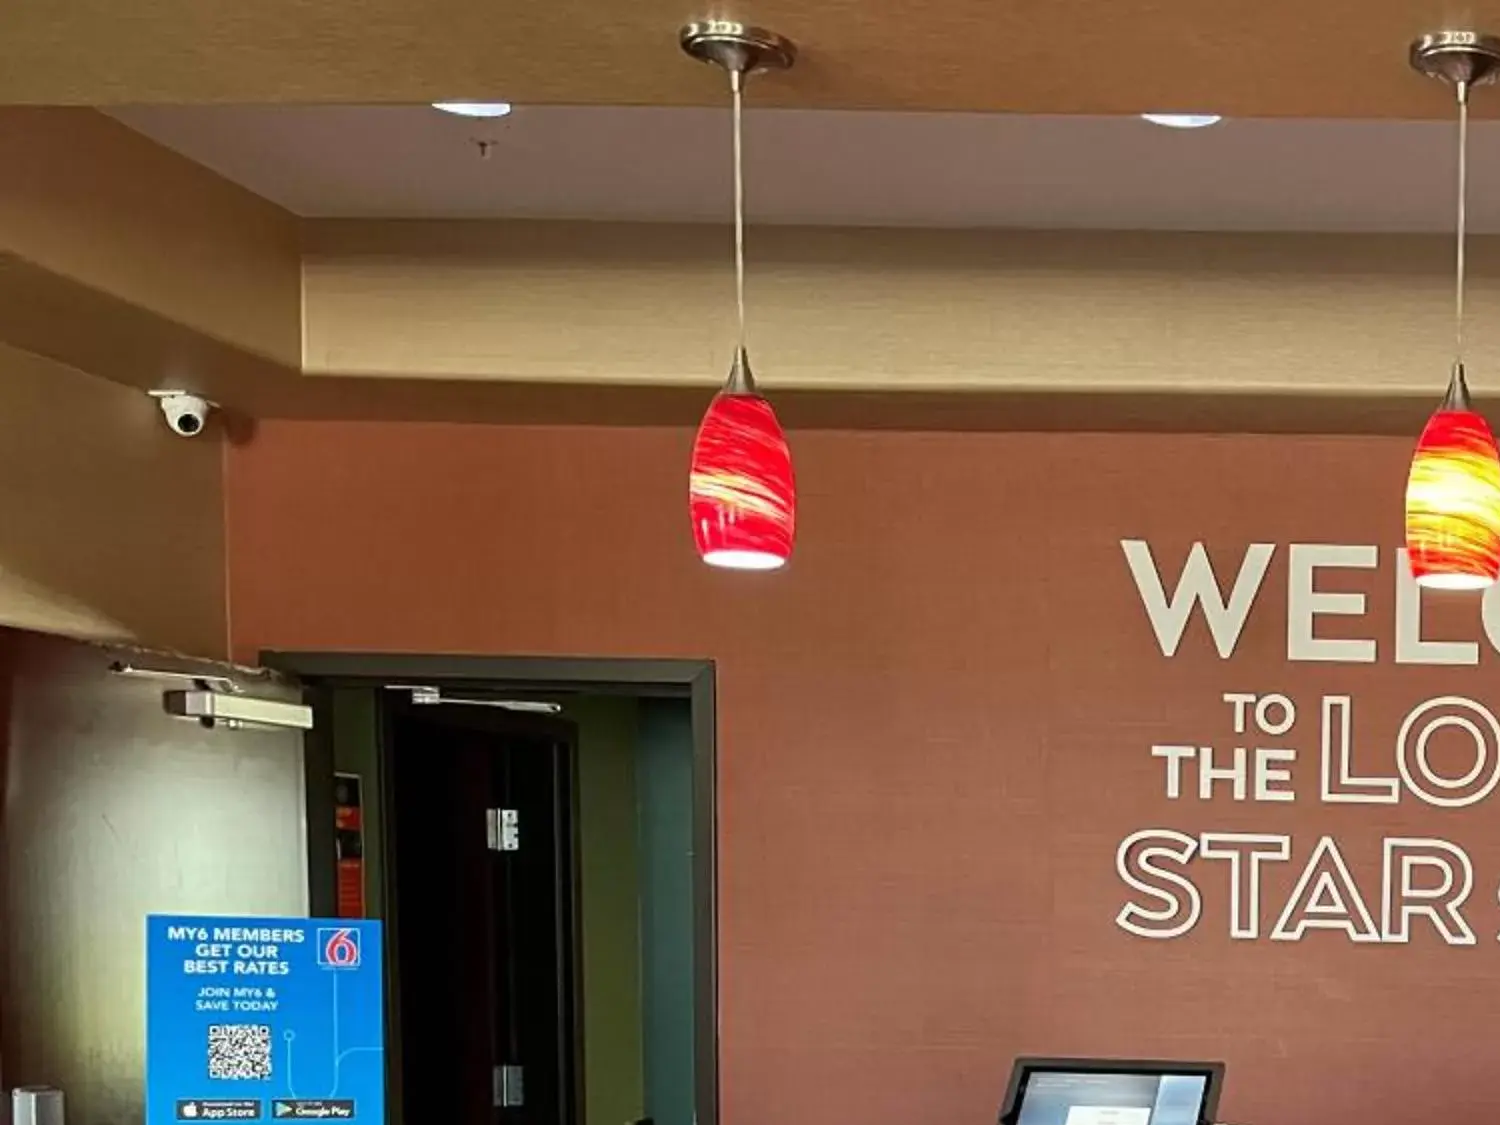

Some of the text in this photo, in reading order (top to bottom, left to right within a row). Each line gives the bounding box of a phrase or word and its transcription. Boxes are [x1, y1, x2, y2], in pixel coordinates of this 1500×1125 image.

[1222, 693, 1296, 735] TO
[1151, 745, 1297, 801] THE
[1115, 829, 1477, 945] STAR
[167, 926, 305, 943] MY6 MEMBERS
[195, 943, 278, 959] GET OUR
[183, 959, 289, 975] BEST RATES
[197, 987, 231, 998] JOIN
[195, 1000, 279, 1012] SAVE TODAY
[202, 1106, 256, 1119] App Store
